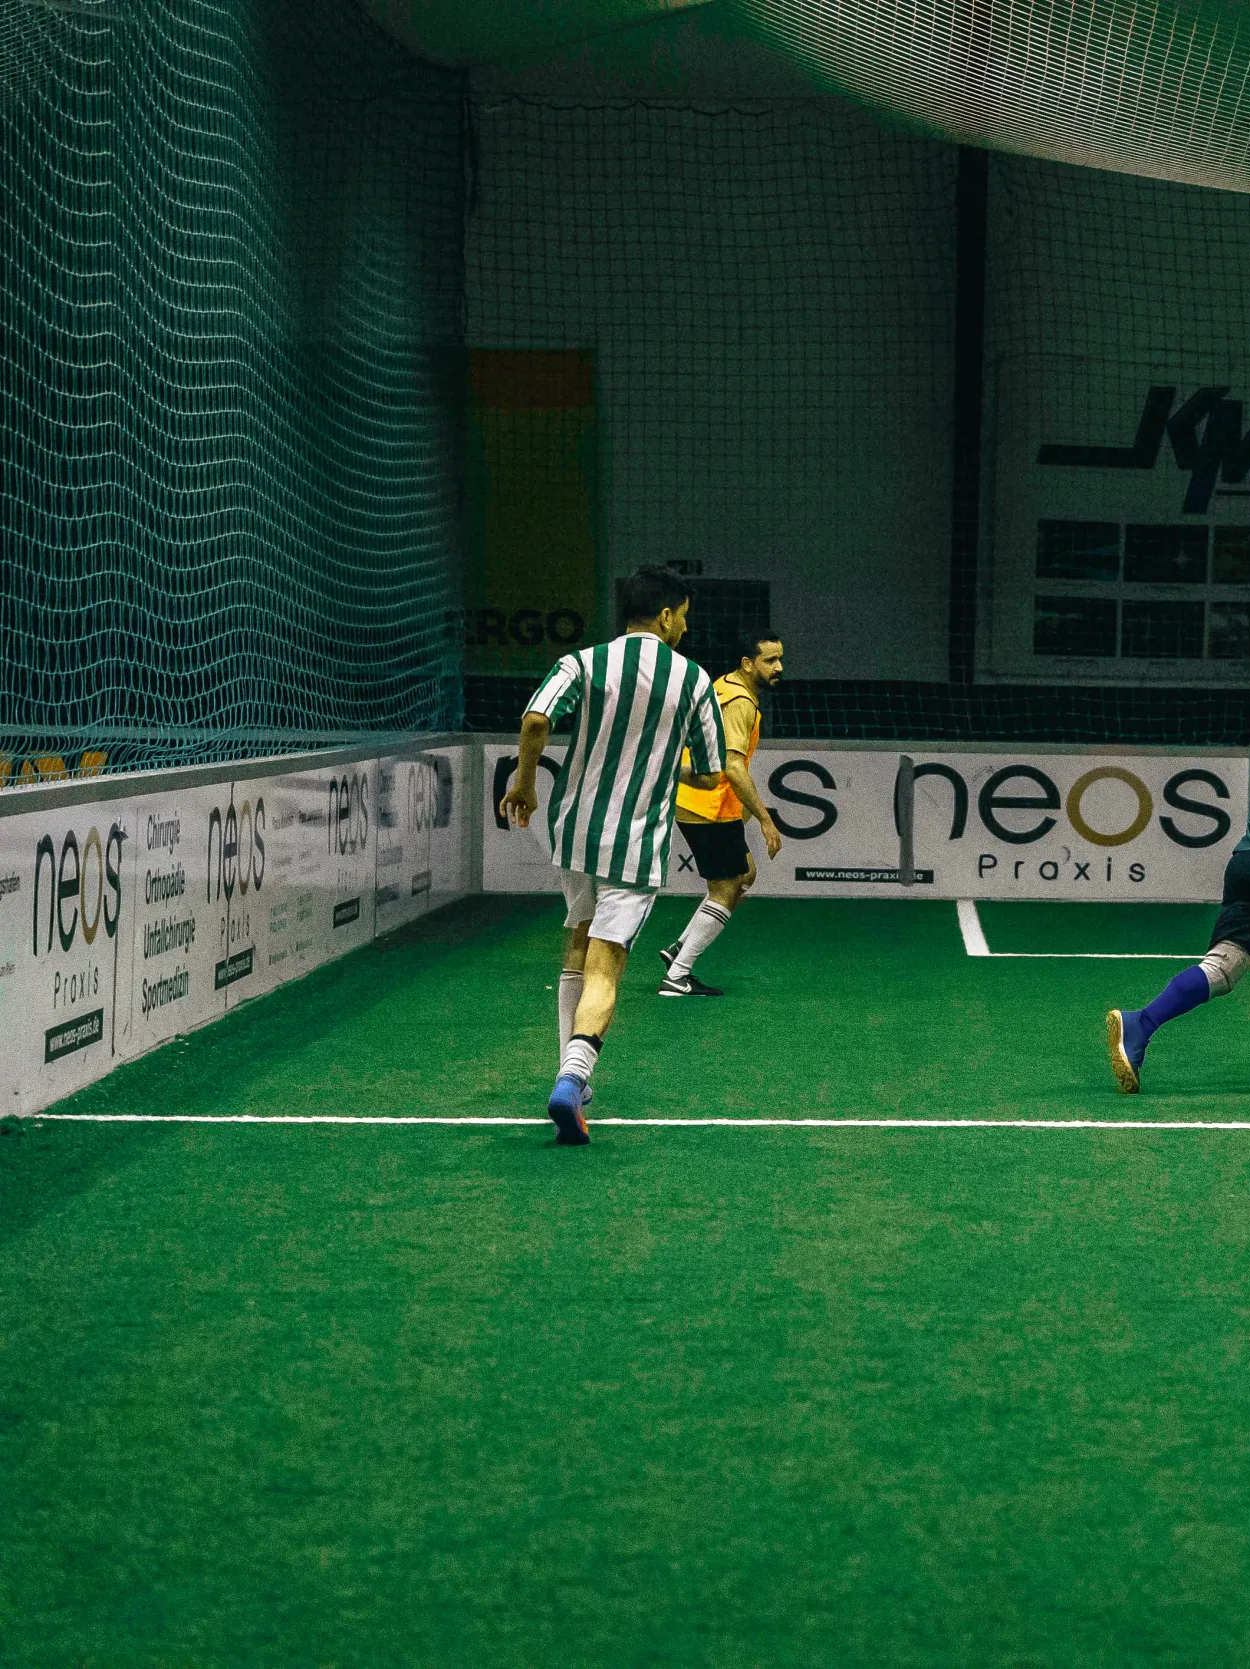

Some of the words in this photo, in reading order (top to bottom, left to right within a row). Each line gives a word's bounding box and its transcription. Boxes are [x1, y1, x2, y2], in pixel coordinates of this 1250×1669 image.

[146, 811, 181, 855] Chirurgie
[893, 761, 1231, 849] neos
[207, 797, 266, 905] neos
[978, 854, 1146, 883] Praxis
[33, 822, 122, 957] neos
[53, 960, 99, 1010] Praxis
